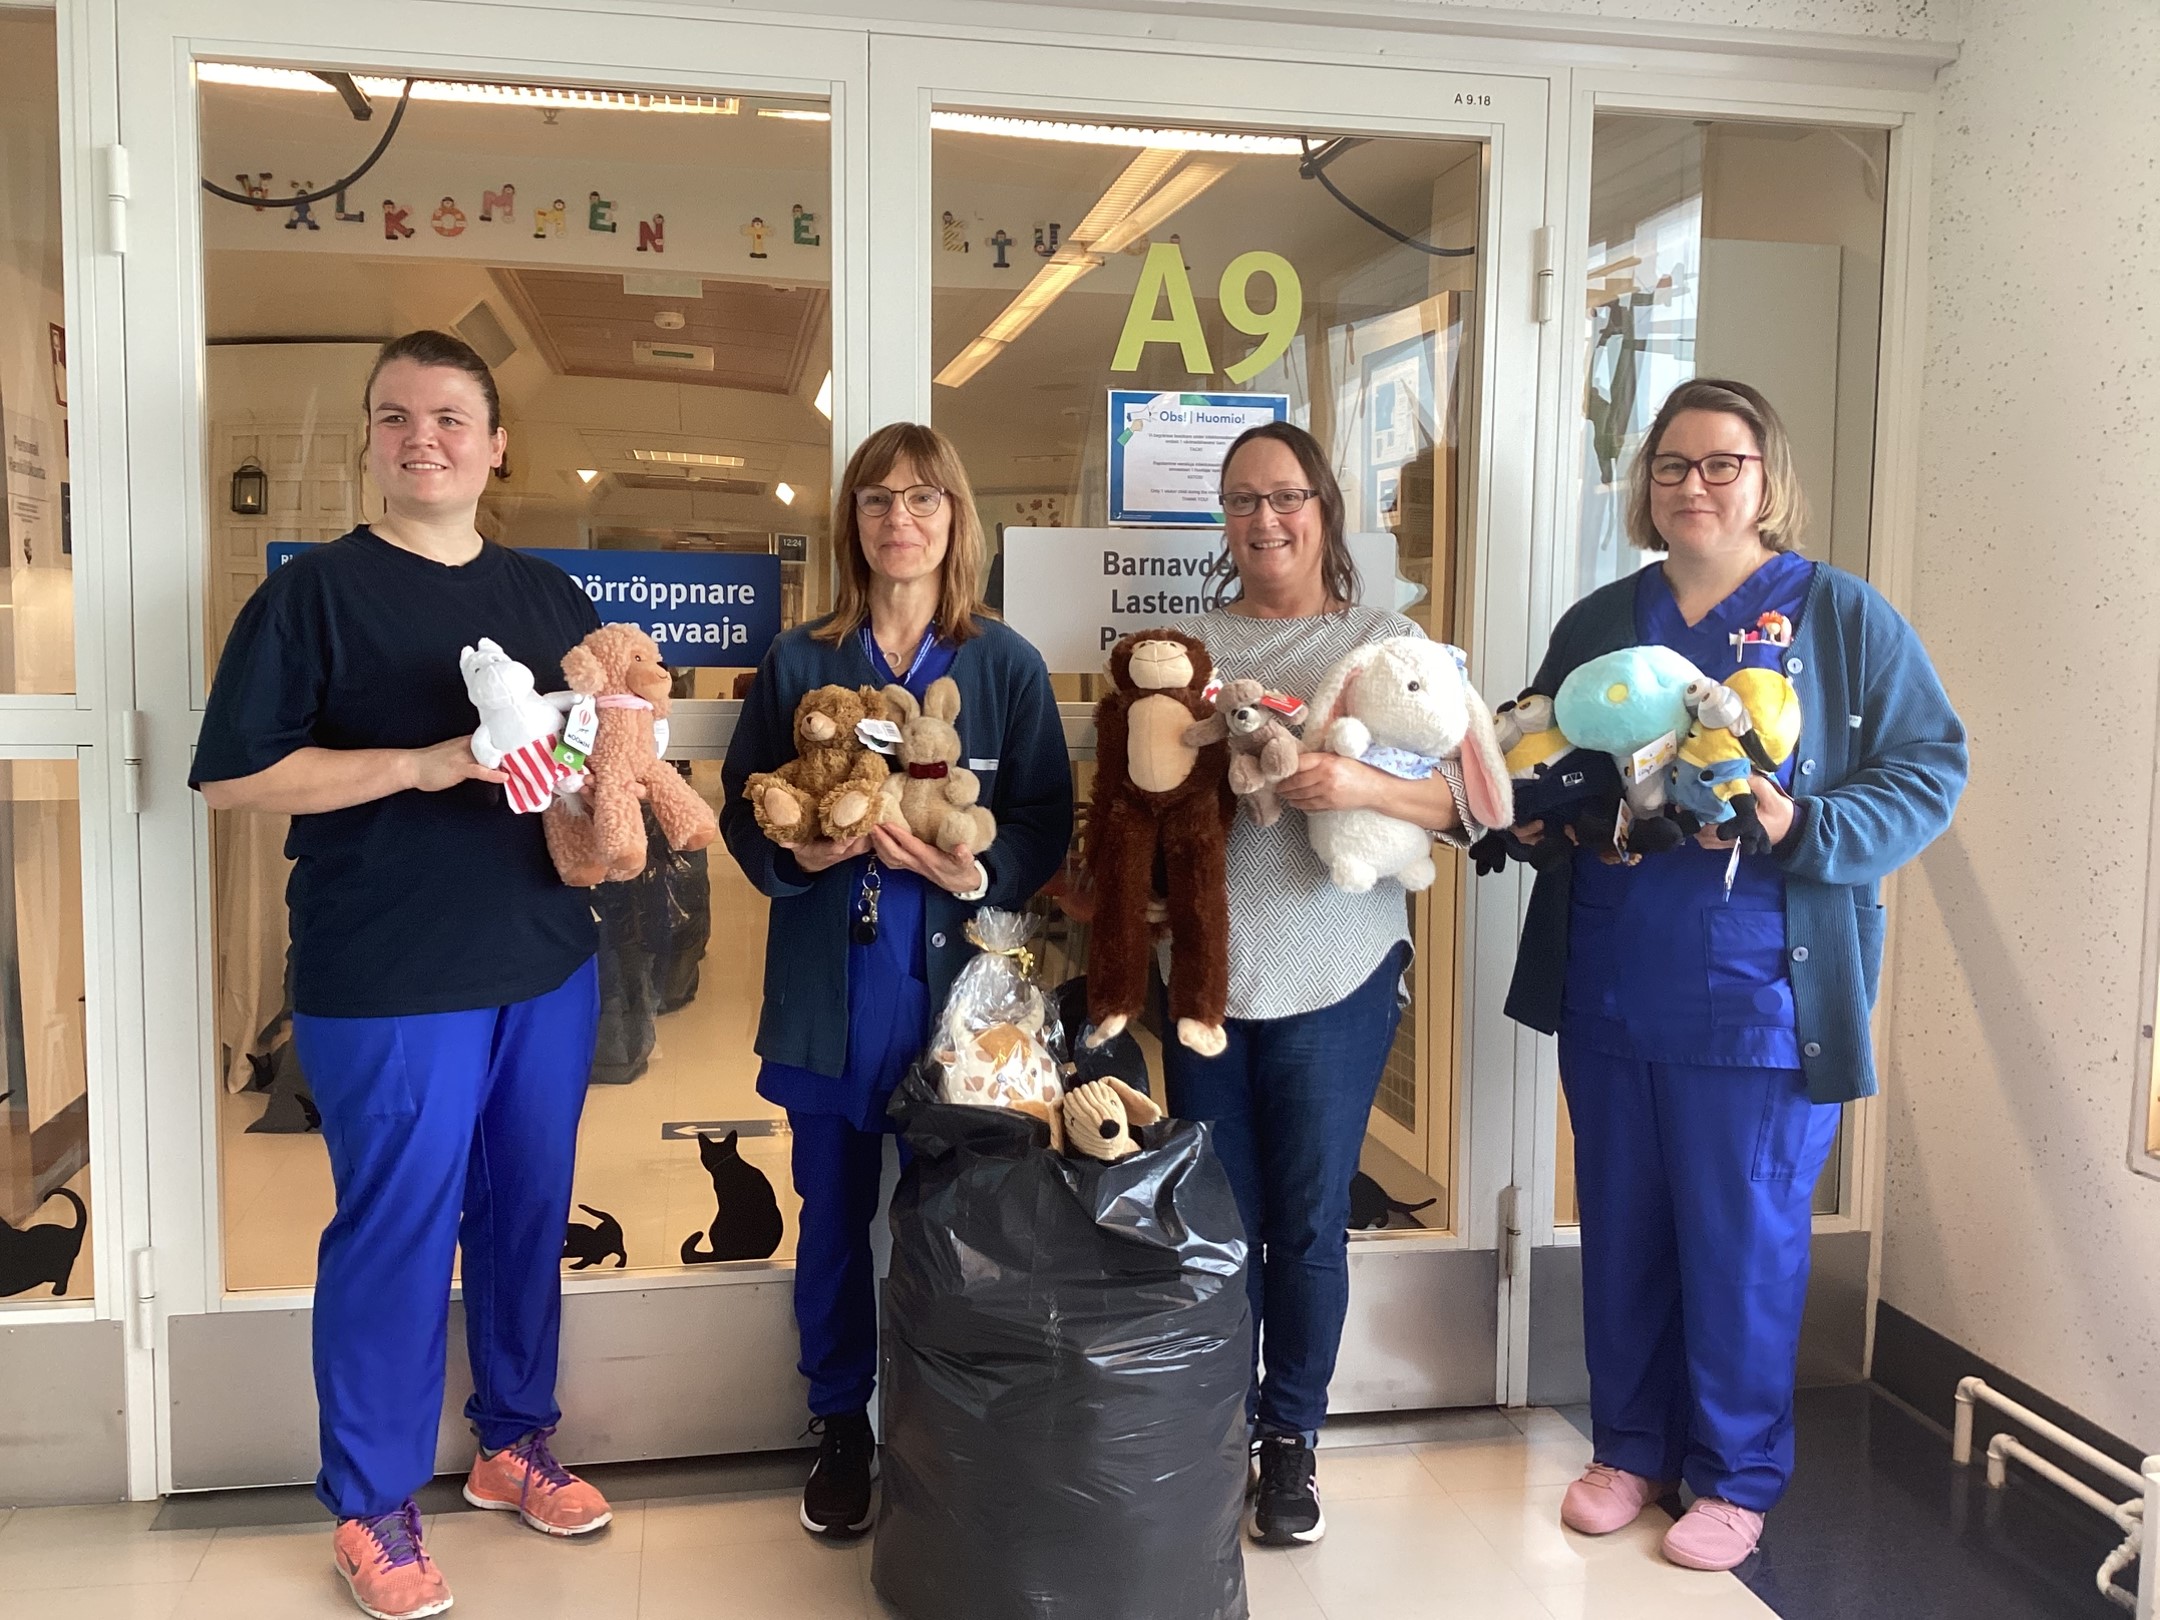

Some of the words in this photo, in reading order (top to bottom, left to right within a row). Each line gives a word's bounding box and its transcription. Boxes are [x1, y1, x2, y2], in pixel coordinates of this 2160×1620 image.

[1454, 93, 1463, 104] A
[1466, 94, 1491, 106] 9.18
[1110, 241, 1303, 386] A9
[1159, 410, 1187, 423] Obs!
[1196, 411, 1246, 425] Huomio!
[651, 616, 748, 650] avaaja
